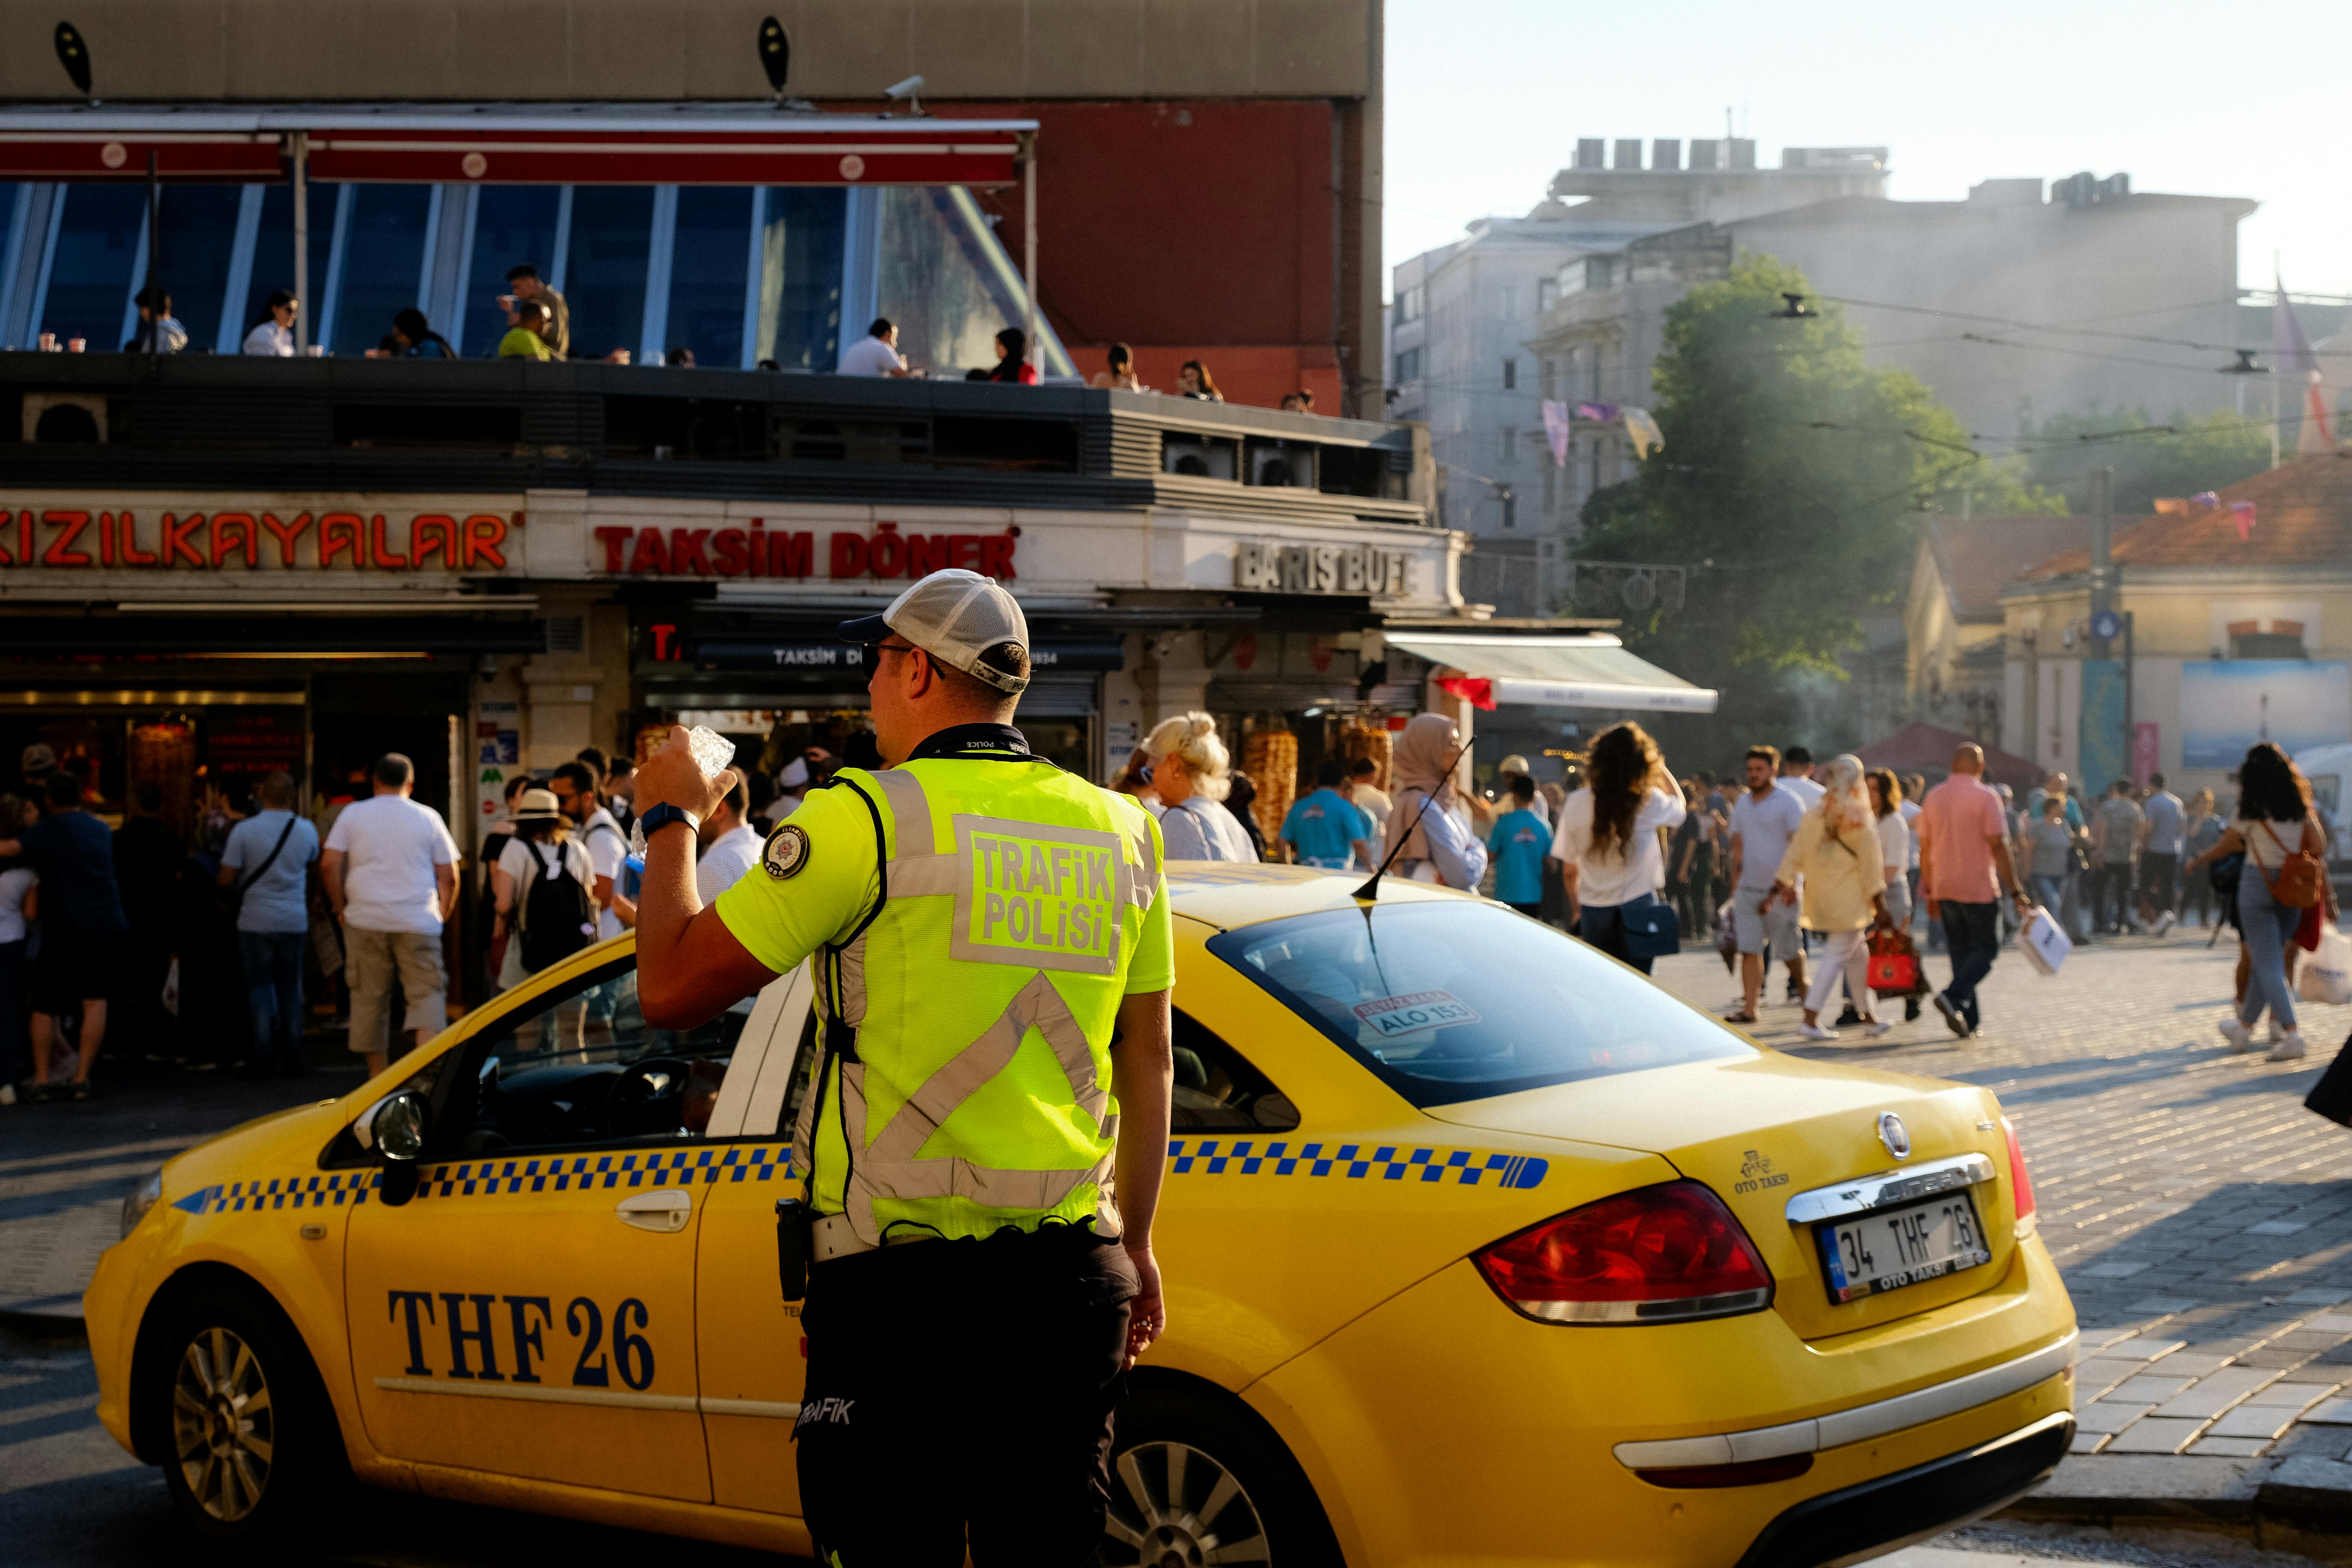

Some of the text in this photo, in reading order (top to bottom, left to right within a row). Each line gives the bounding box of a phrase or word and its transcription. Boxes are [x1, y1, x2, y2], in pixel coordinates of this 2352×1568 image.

[0, 510, 507, 567] IZILKAYALAR
[594, 518, 1017, 579] TAKSİM DÖNER
[773, 647, 836, 664] TAKSİM
[974, 837, 1112, 902] TRAFİK
[983, 892, 1104, 951] POLİSİ
[1380, 1004, 1469, 1033] ALO 153
[1734, 1180, 1758, 1195] OTO
[1841, 1227, 1874, 1279] 34
[1888, 1212, 1930, 1265] THF
[1880, 1273, 1908, 1290] OTO
[387, 1289, 655, 1391] THF 26
